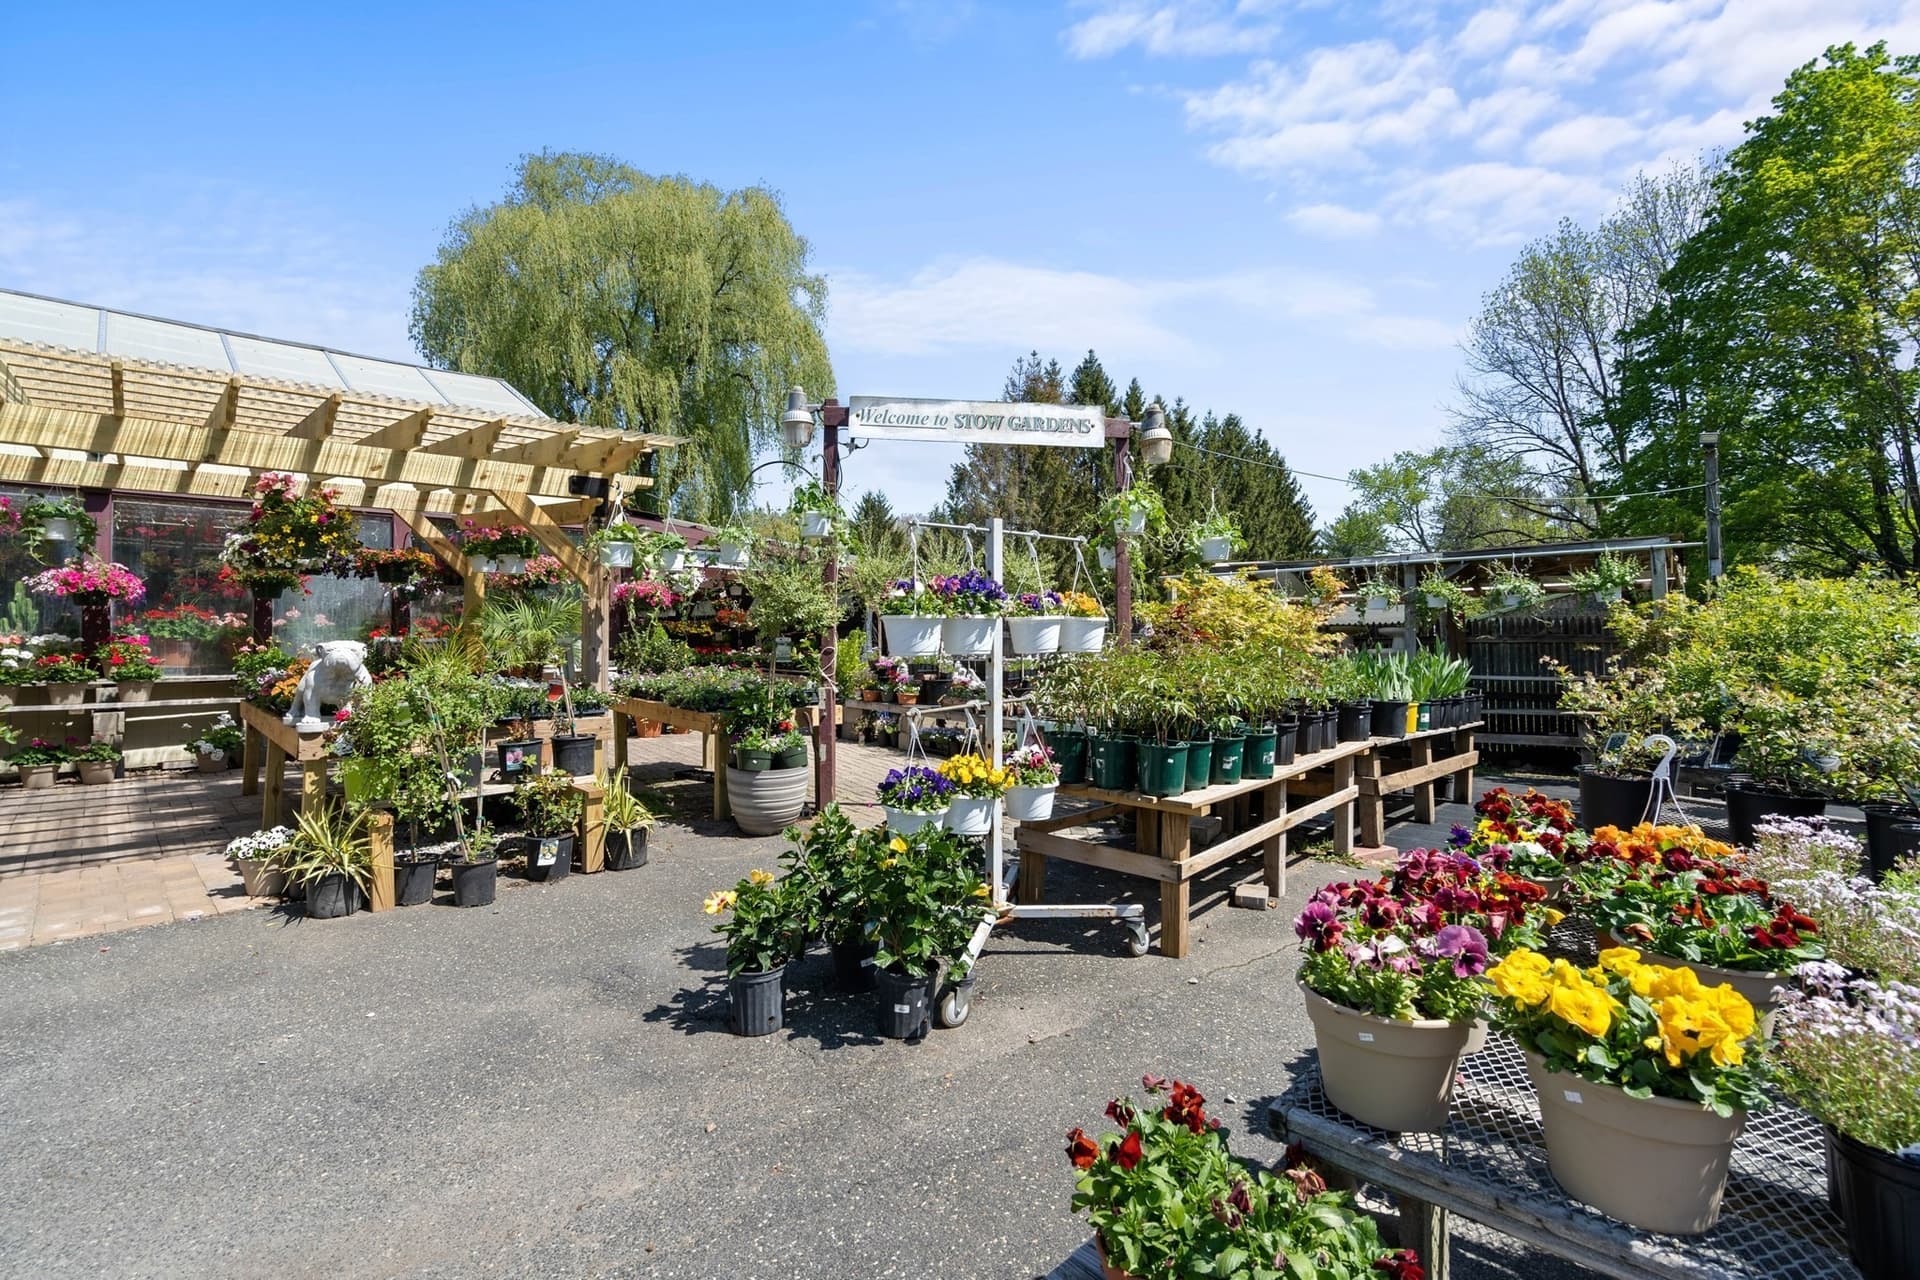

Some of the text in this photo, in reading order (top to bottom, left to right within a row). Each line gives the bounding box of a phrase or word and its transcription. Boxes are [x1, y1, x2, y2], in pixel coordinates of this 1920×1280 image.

[860, 407, 1091, 434] Welcome to STOW GARDENS
